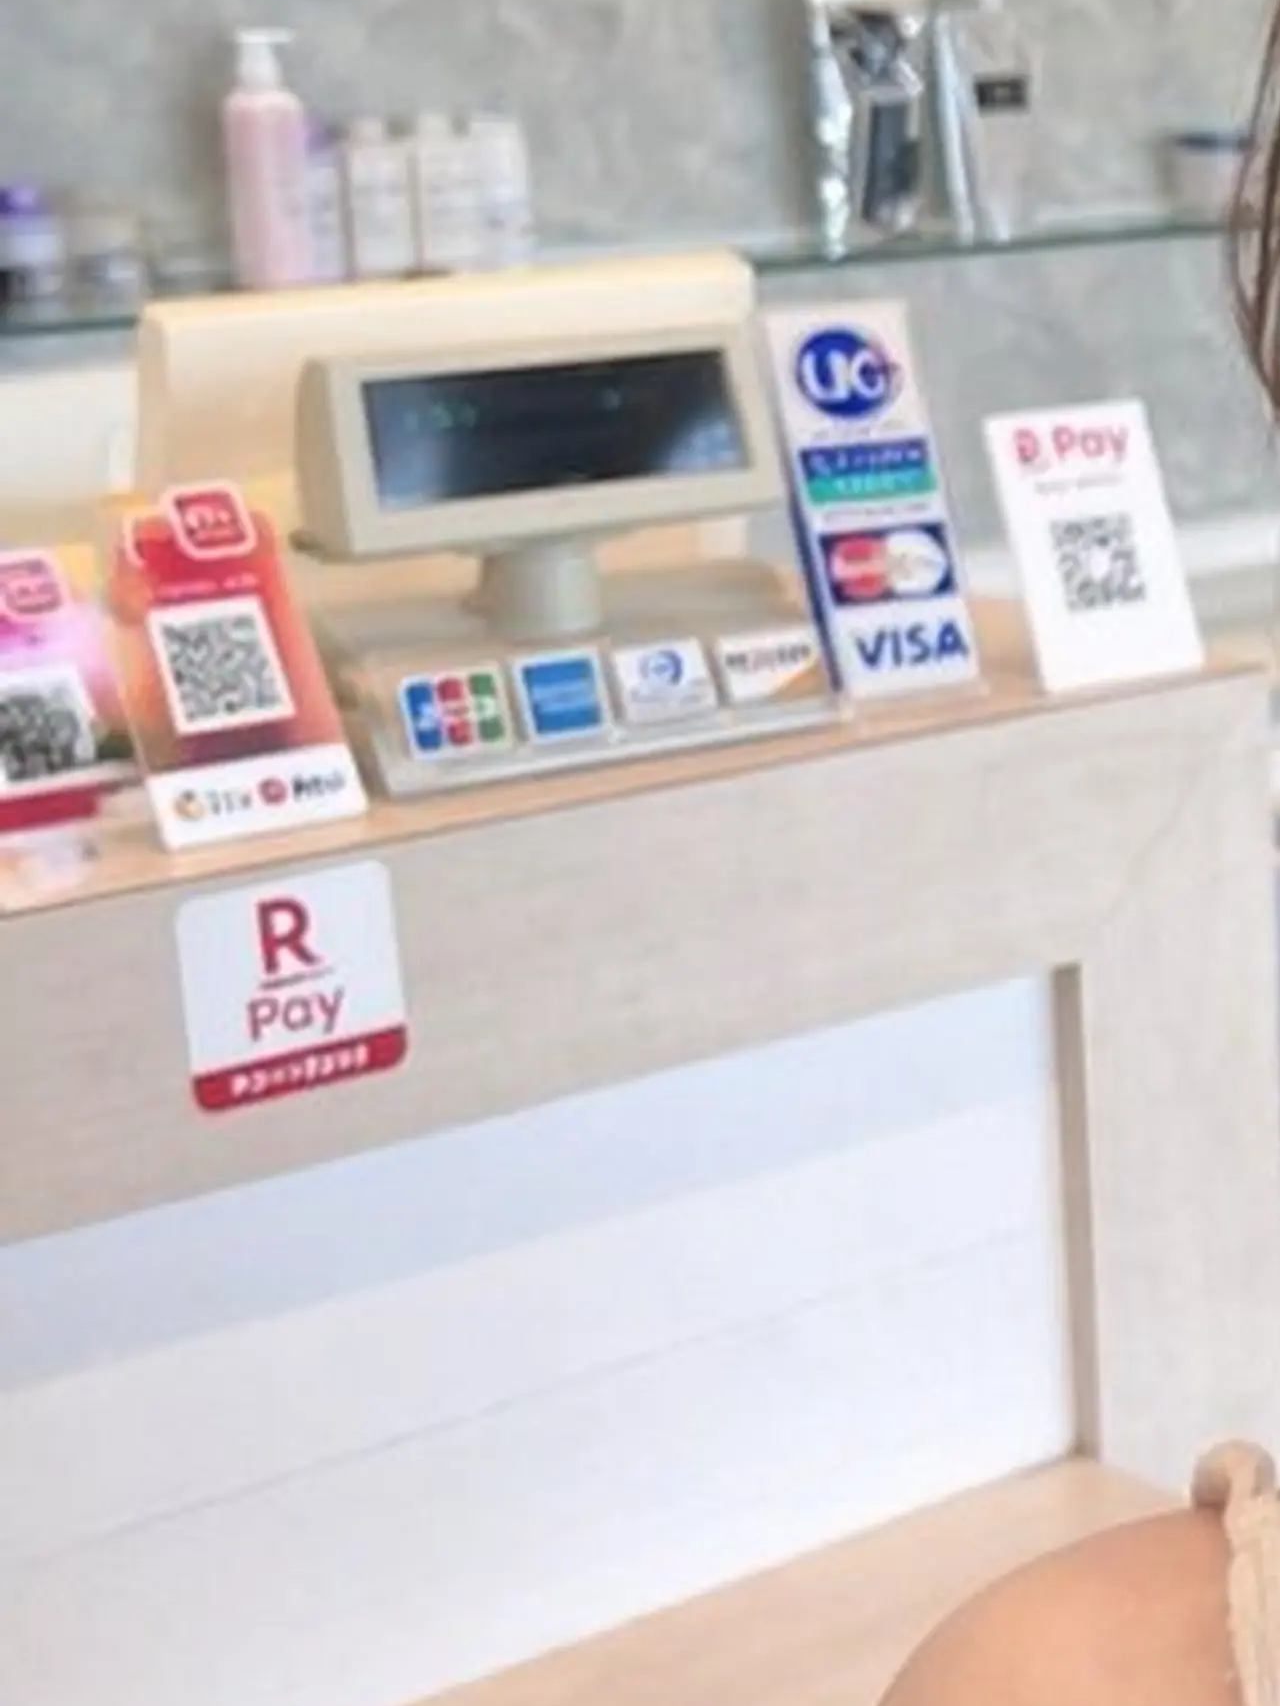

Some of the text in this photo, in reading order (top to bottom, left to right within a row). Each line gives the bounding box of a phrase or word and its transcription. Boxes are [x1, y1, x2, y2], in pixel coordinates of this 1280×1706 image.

[800, 348, 888, 402] UC
[1052, 425, 1129, 465] Pay
[854, 620, 970, 669] VISA
[256, 897, 321, 974] R
[246, 987, 346, 1043] Pay
